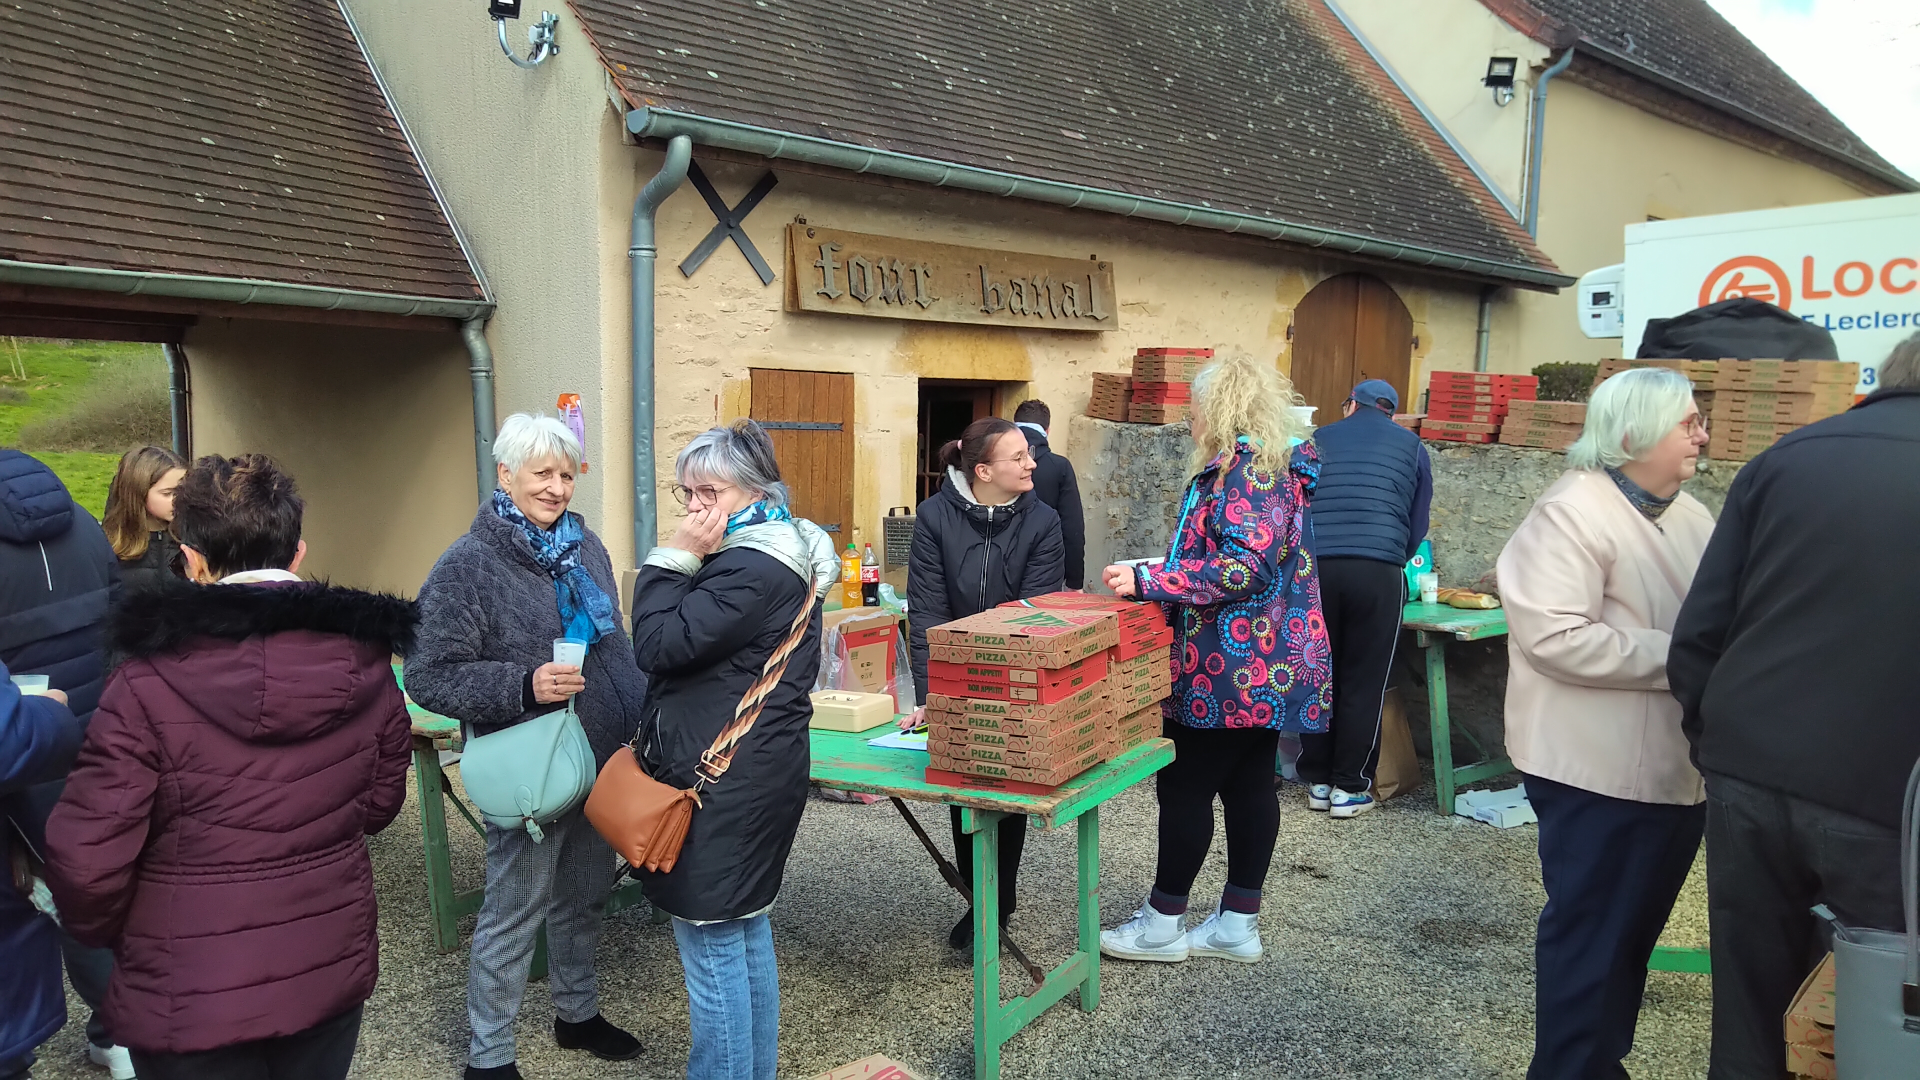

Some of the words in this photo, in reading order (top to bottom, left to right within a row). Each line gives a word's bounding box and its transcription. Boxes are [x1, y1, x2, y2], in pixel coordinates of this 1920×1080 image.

[814, 240, 940, 309] four
[979, 264, 1109, 321] banal
[1080, 626, 1096, 638] PIZZA
[974, 635, 1006, 646] PIZZA
[1082, 642, 1099, 655] PIZZA
[975, 652, 1008, 663] PIZZA
[1134, 654, 1150, 665] PIZZA
[1134, 667, 1150, 678] PIZZA
[1134, 682, 1150, 693] PIZZA
[1078, 690, 1093, 703] PIZZA
[1138, 695, 1152, 706] PIZZA
[974, 703, 1007, 714] PIZZA
[1073, 708, 1092, 722] PIZZA
[968, 717, 999, 729] PIZZA
[1078, 722, 1095, 736] PIZZA
[1127, 723, 1142, 735] PIZZA
[974, 734, 1006, 745] PIZZA
[1127, 736, 1142, 748] PIZZA
[1077, 739, 1094, 753] PIZZA
[971, 749, 1002, 761] PIZZA
[1081, 753, 1098, 767] PIZZA
[976, 765, 1008, 777] PIZZA
